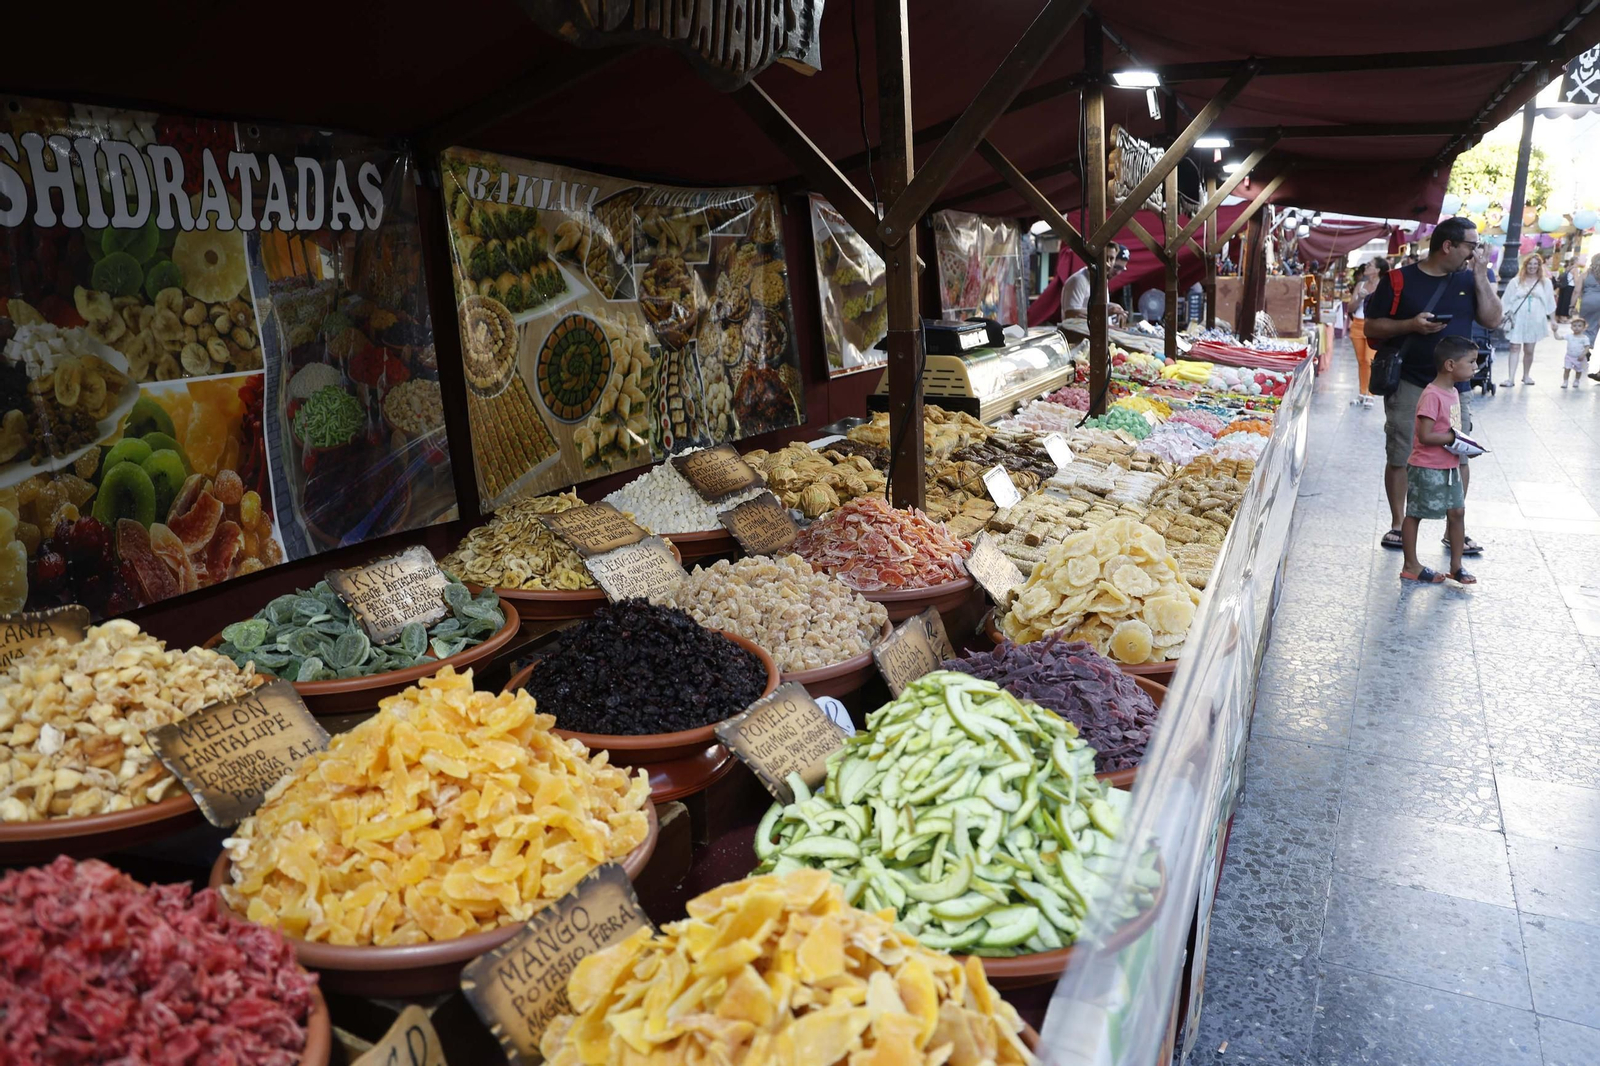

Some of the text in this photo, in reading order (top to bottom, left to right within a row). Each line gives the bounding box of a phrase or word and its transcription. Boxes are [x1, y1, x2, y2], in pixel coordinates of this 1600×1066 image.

[466, 166, 599, 212] BAKLAVA
[730, 503, 770, 527] PAPAYA
[581, 540, 590, 549] Y
[590, 538, 605, 547] LA
[595, 545, 656, 573] JENGIBRE
[347, 561, 404, 591] KIWI
[605, 555, 667, 586] PARA GARGANTA
[373, 606, 394, 620] RICO
[396, 602, 409, 611] EN
[400, 600, 440, 620] VITAMINA
[0, 621, 55, 648] ANA
[891, 645, 923, 683] MORADA
[738, 699, 798, 745] POMELO
[180, 712, 293, 772] CANTALUPE
[750, 722, 797, 760] VITAMINAS
[764, 754, 789, 775] BUENO
[785, 739, 806, 758] PARA
[198, 749, 266, 790] CONTENIDO
[214, 755, 285, 794] VITAMINA
[800, 755, 810, 768] Y
[588, 904, 636, 949] FIBRA
[498, 906, 590, 994] MANGO
